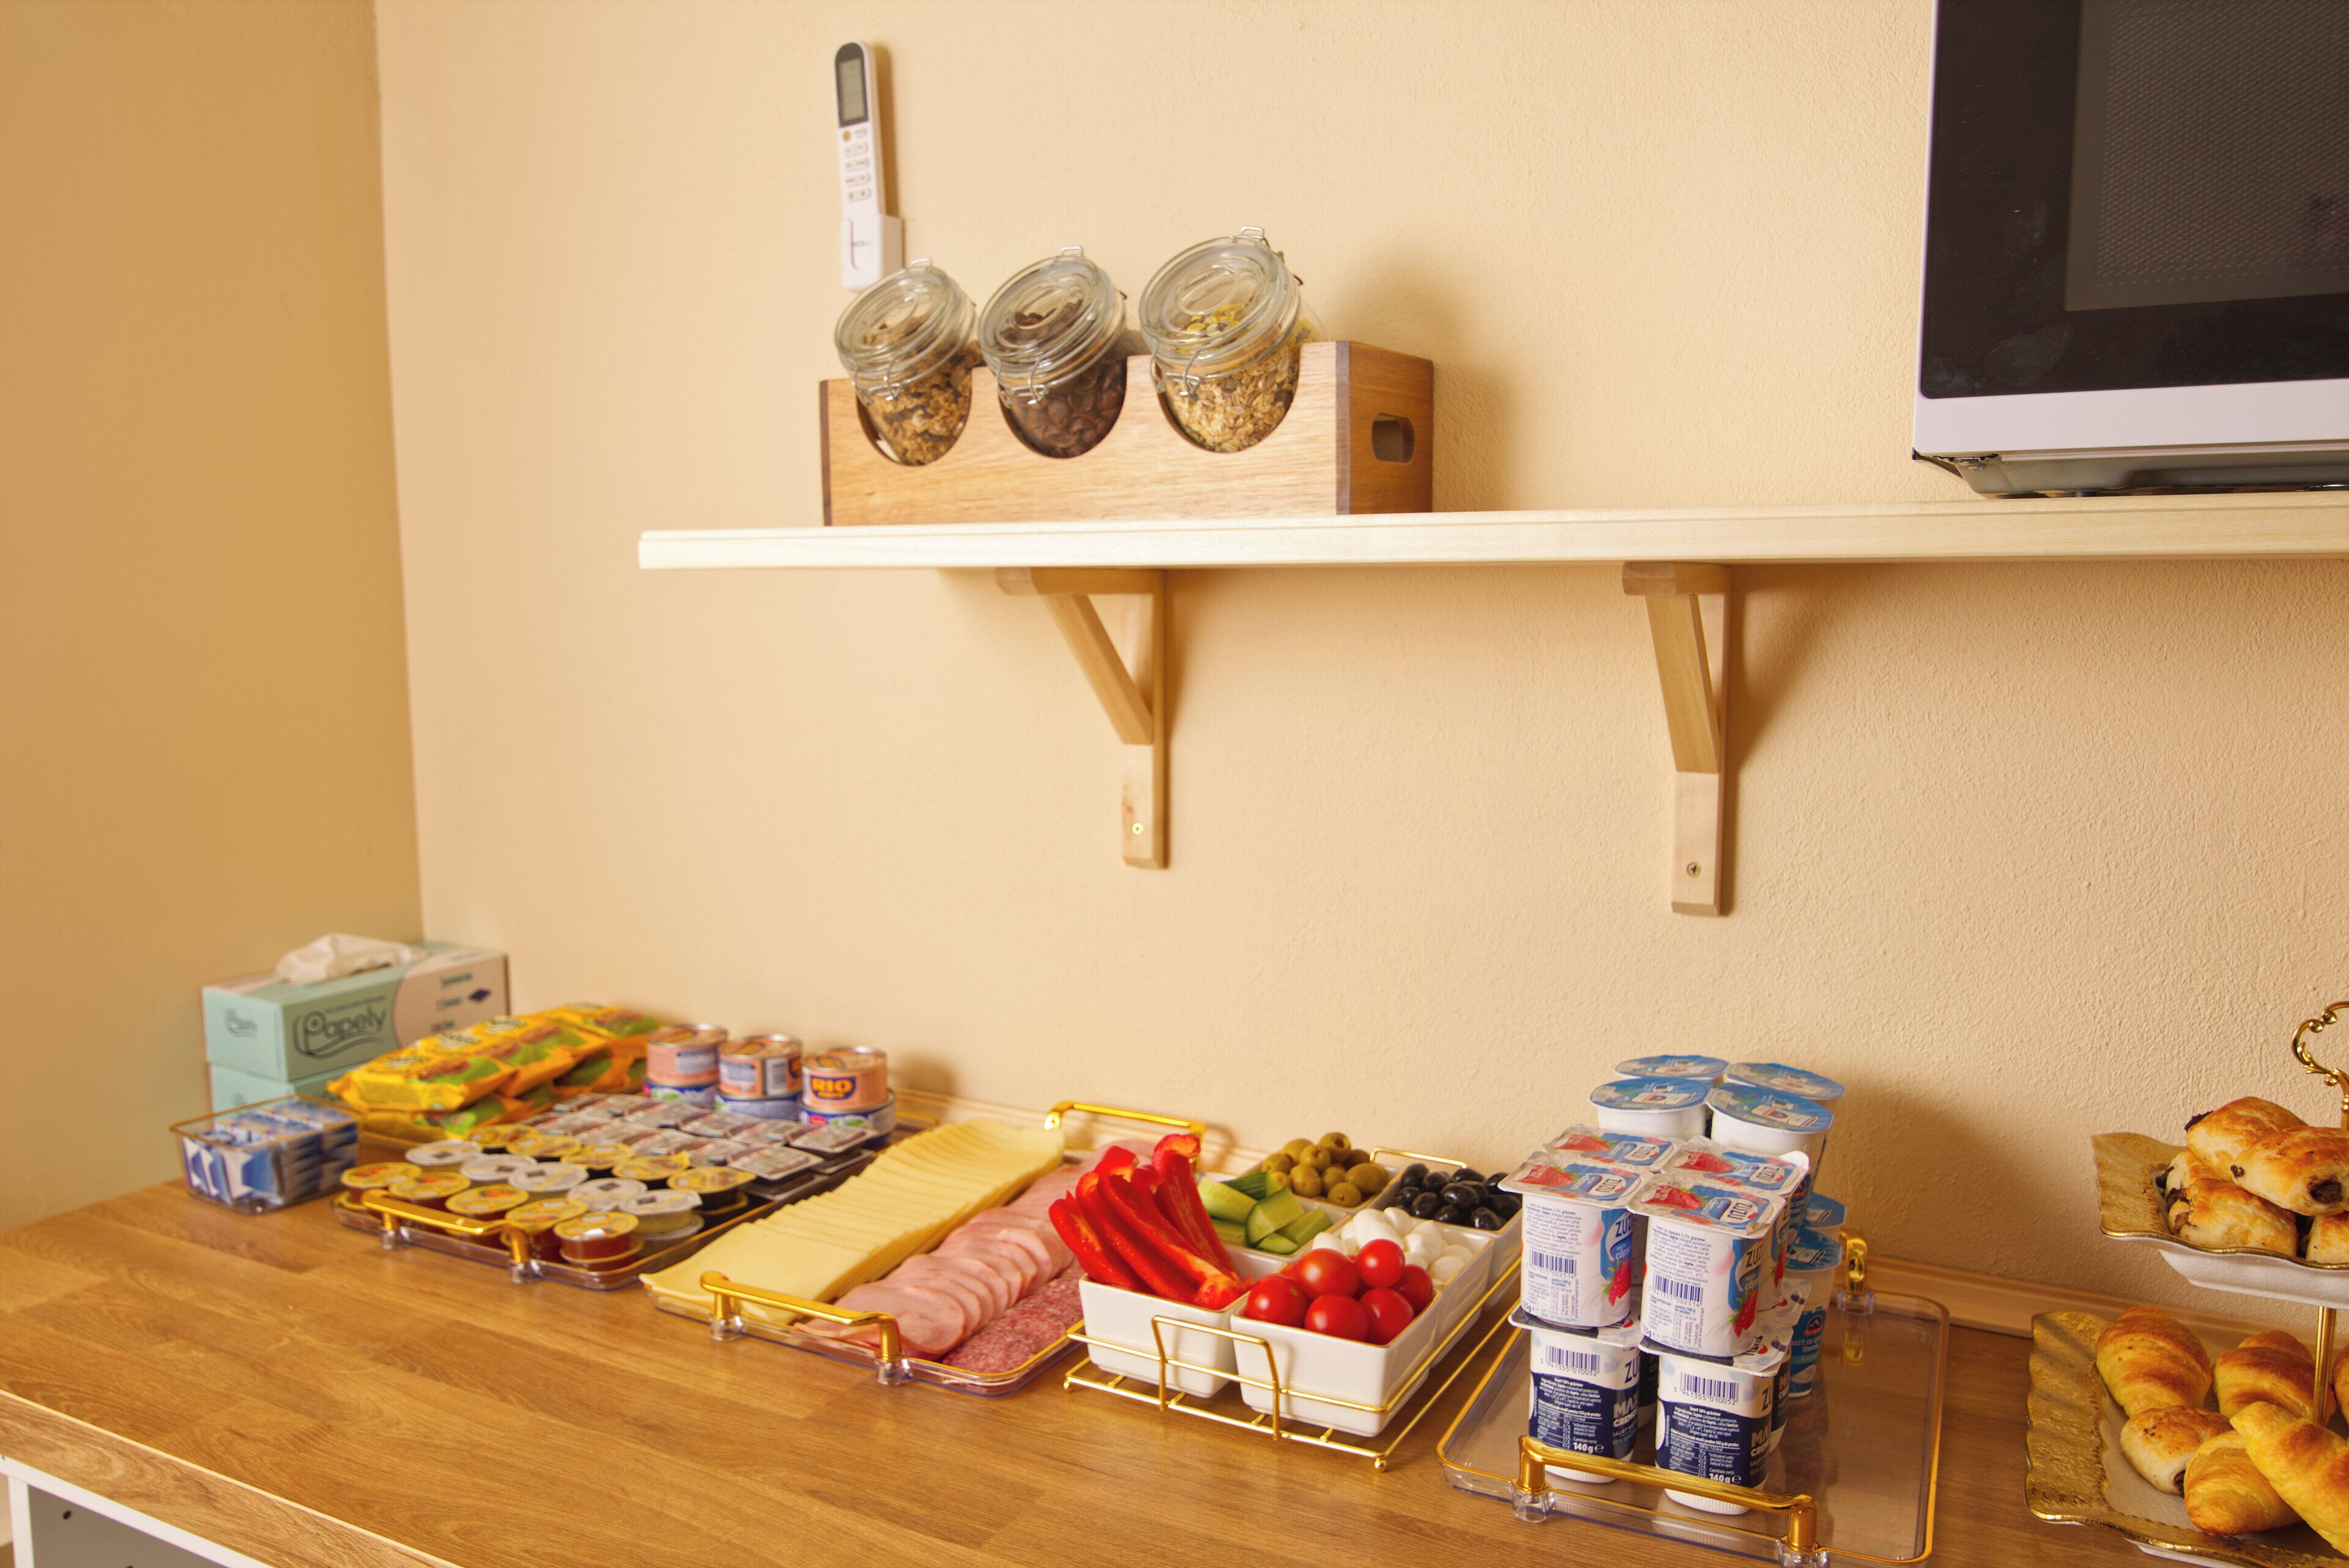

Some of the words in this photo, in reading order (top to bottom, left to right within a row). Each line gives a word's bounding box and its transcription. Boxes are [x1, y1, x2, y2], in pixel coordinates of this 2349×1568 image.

[296, 1003, 388, 1056] Papely
[811, 1078, 853, 1093] RIO
[1595, 1178, 1622, 1193] ZUZU
[1727, 1202, 1753, 1220] ZUZU
[1615, 1215, 1631, 1238] ZUZ
[1746, 1244, 1762, 1268] ZUZ
[1676, 1298, 1700, 1307] 002514
[1548, 1361, 1569, 1372] 941355
[1573, 1367, 1597, 1377] 010052
[1625, 1358, 1638, 1383] ZU
[1682, 1389, 1706, 1400] 941355
[1710, 1397, 1736, 1405] 010052
[1613, 1409, 1637, 1427] CREM
[1573, 1442, 1594, 1454] 140g
